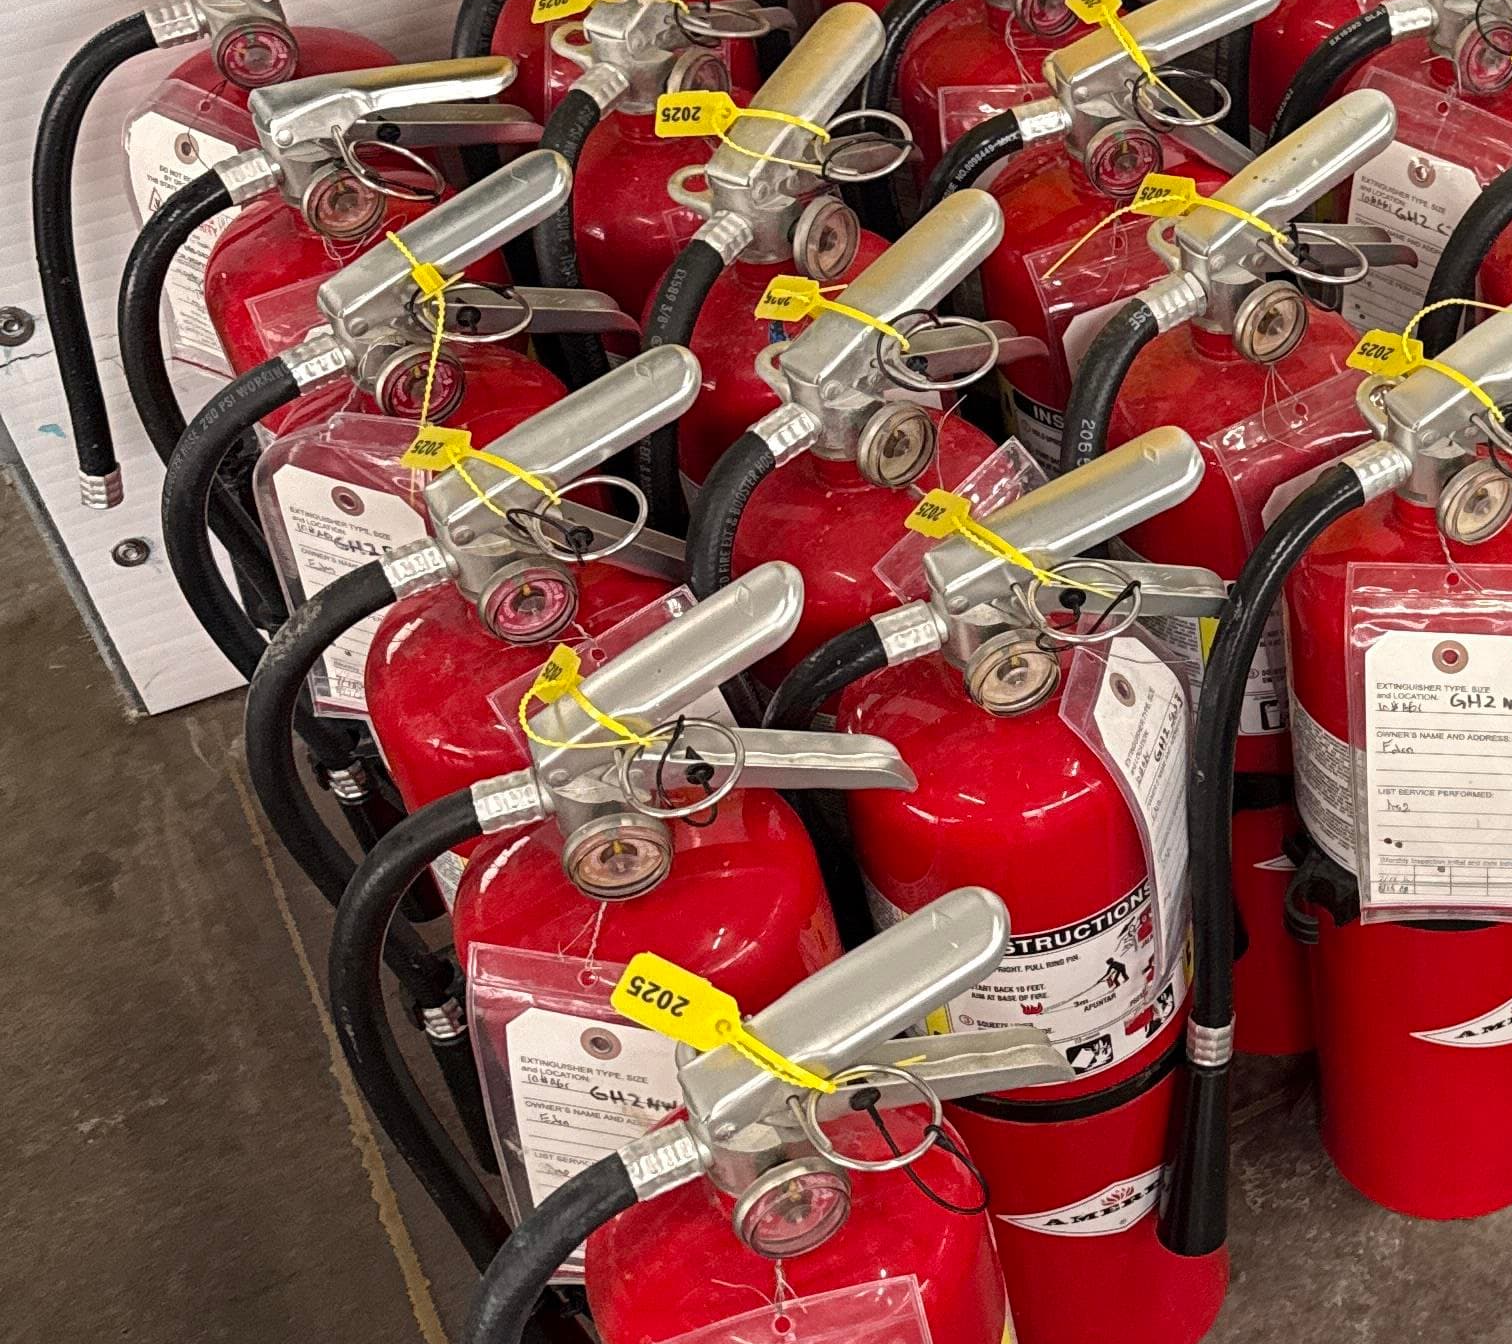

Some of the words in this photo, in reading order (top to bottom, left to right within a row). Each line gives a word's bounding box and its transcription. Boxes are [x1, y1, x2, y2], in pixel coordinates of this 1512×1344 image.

[661, 106, 701, 122] 2025
[1357, 342, 1395, 361] 2025
[410, 439, 445, 457] 2025
[915, 502, 946, 521] 2025
[1376, 683, 1441, 691] EXTINGUISHER
[1450, 693, 1496, 709] GH2
[1376, 731, 1417, 739] OWNER'S
[1420, 732, 1444, 740] NAME
[1005, 882, 1152, 954] STRUCTIONS
[626, 975, 690, 1017] 2025
[521, 1055, 593, 1074] EXTINGUISHER
[1042, 1178, 1163, 1227] AMERE
